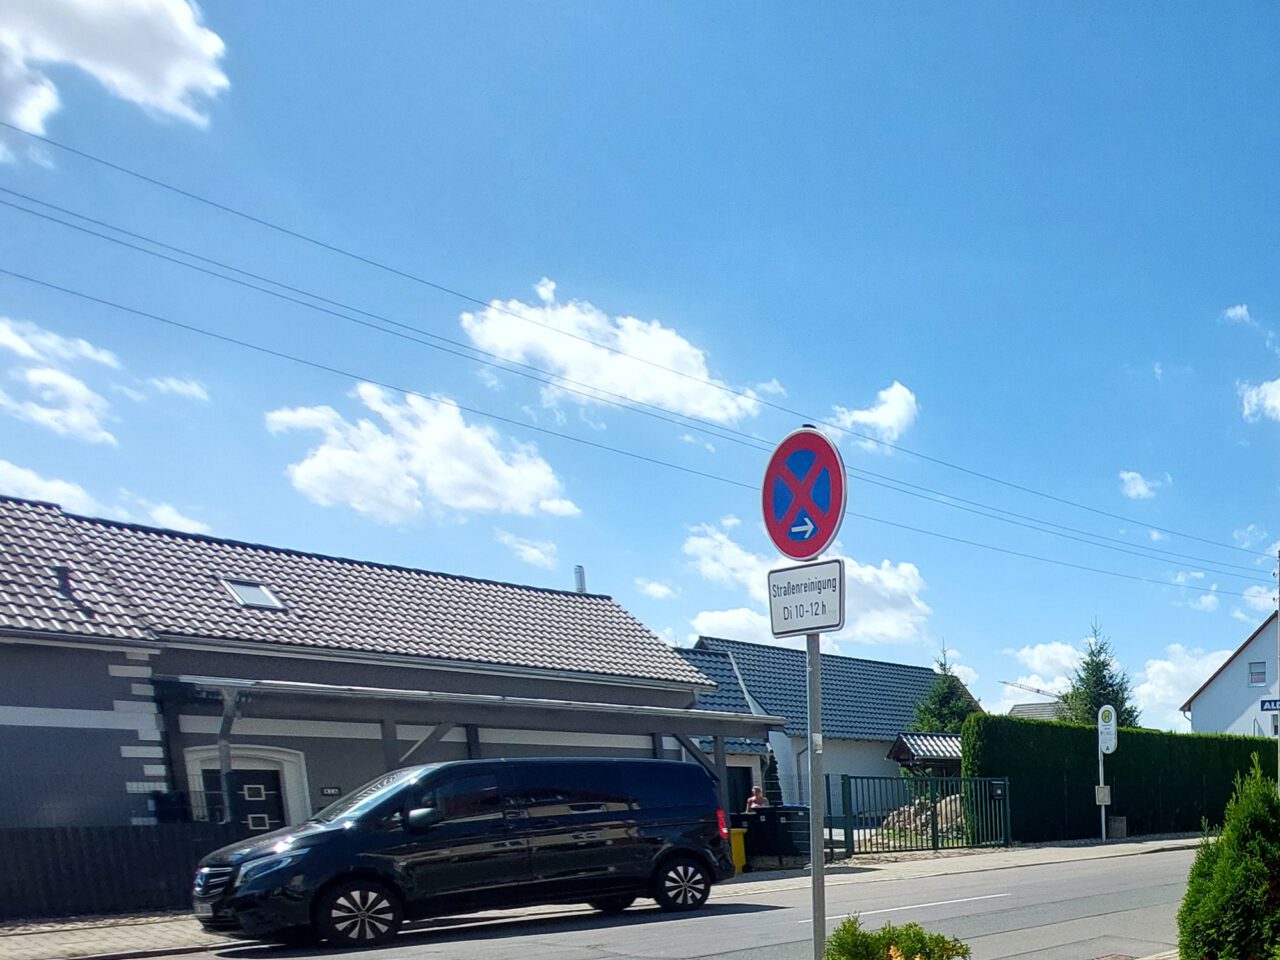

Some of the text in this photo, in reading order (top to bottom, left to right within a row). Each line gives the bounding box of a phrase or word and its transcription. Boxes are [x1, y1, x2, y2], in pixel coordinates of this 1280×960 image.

[772, 577, 836, 598] Straßenreinigung
[783, 606, 792, 620] Di
[821, 600, 827, 615] h
